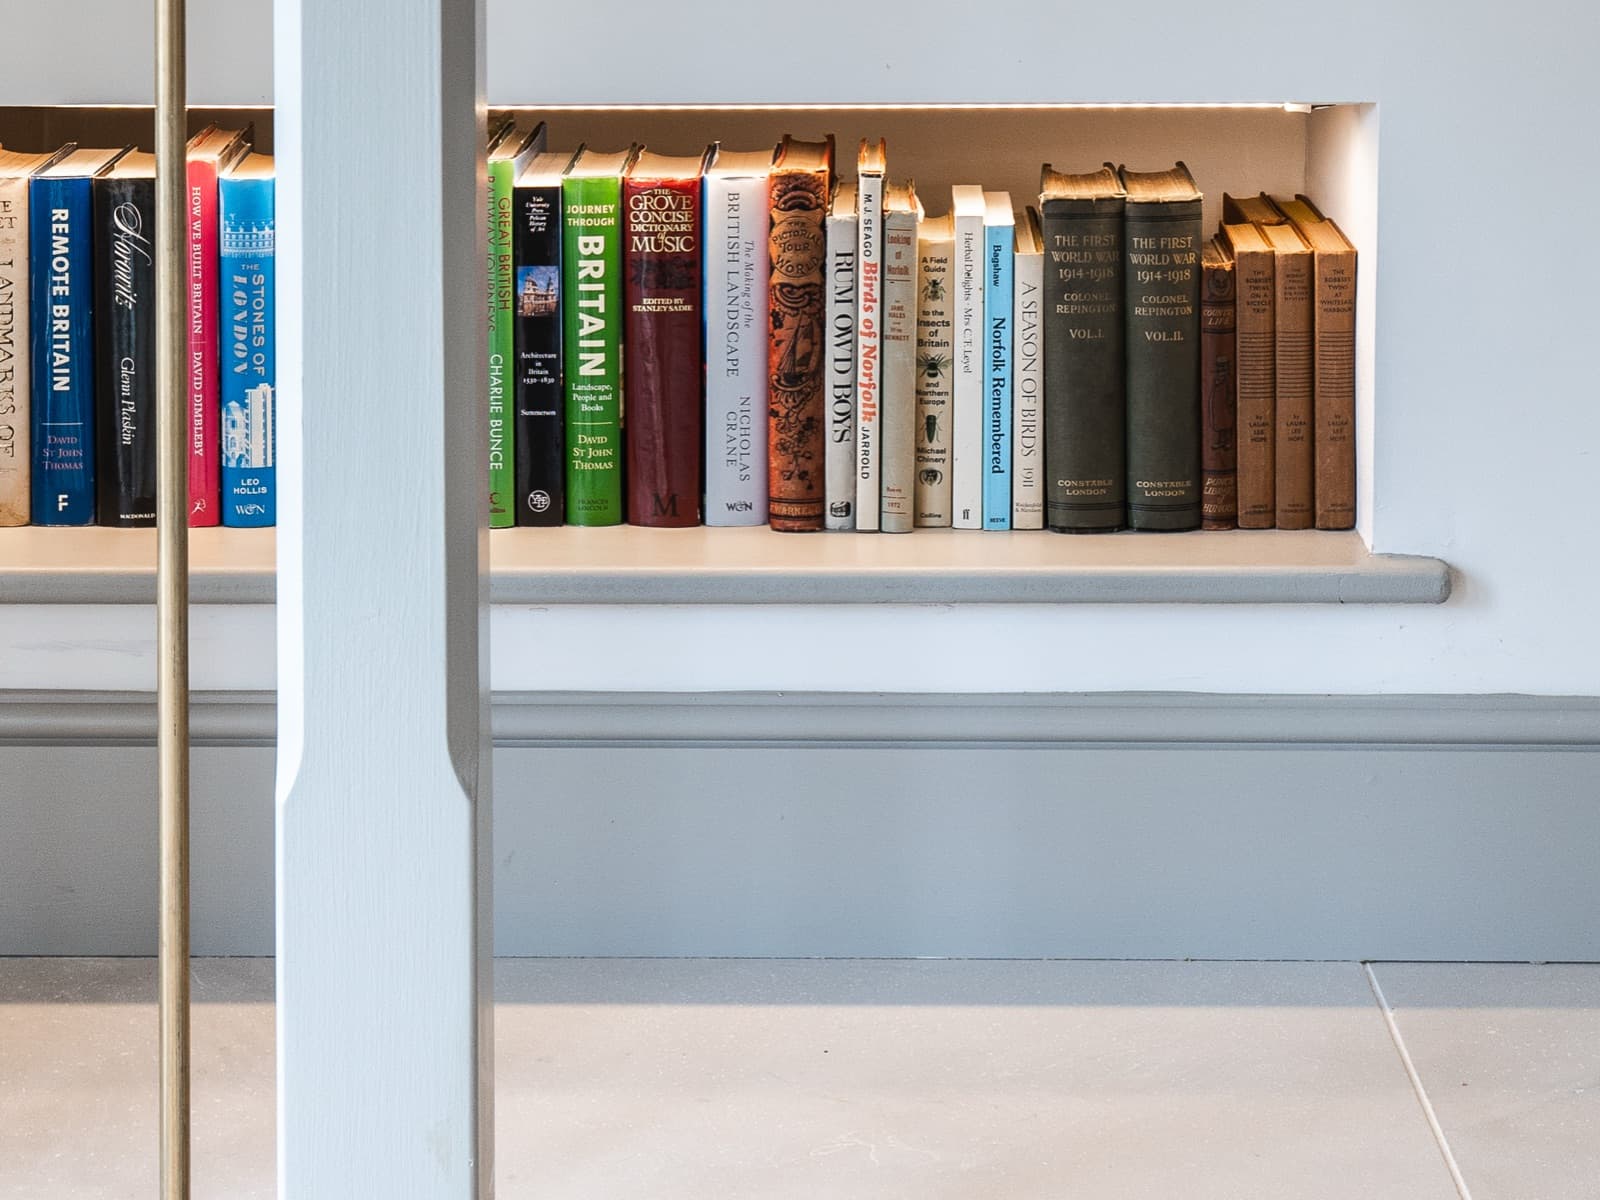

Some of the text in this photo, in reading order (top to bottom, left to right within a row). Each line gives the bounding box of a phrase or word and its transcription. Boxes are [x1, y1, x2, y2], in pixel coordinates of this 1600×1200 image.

[566, 204, 615, 214] JOURNEY
[629, 195, 694, 211] GROVE
[567, 217, 615, 227] THROUGH
[630, 211, 694, 223] CONCISE
[630, 223, 694, 233] DICTIONARY
[772, 229, 821, 246] PICTORIAL
[864, 218, 873, 258] SEAGO
[1055, 236, 1115, 247] THE FIRST
[1132, 236, 1193, 249] THE FIRST
[631, 237, 695, 253] MUSIC
[743, 240, 755, 258] The
[779, 240, 810, 253] TOUR
[963, 232, 974, 262] Herbal
[191, 186, 202, 334] HOW WE BUILT BRITAIN
[497, 197, 511, 311] GREAT BRITISH
[930, 256, 948, 264] Field
[1051, 251, 1120, 263] WORLD WAR
[1130, 252, 1196, 265] WORLD WAR
[775, 255, 819, 275] WORLD
[924, 265, 946, 273] Guide
[991, 244, 1002, 287] Bagshaw
[741, 262, 754, 298] Making
[1059, 268, 1114, 282] 1914-1918
[1137, 270, 1191, 283] 1914-1918
[726, 192, 740, 378] BRITISH LANDSCAPE
[863, 261, 878, 313] Birds
[961, 264, 974, 301] Delights
[1021, 281, 1038, 295] A
[52, 208, 70, 392] REMOTE BRITAIN
[1063, 292, 1110, 303] COLONEL
[1142, 294, 1189, 304] COLONEL
[577, 235, 606, 376] BRITAIN
[1056, 304, 1116, 315] REPINGTON
[1134, 306, 1193, 317] REPINGTON
[233, 275, 248, 374] LONDON
[252, 274, 265, 376] STONES OF
[743, 314, 754, 329] the
[860, 318, 877, 338] of
[918, 319, 951, 327] Insects
[929, 329, 938, 337] of
[1021, 301, 1038, 372] SEASON
[831, 249, 855, 444] RUM OWD BOYS
[917, 339, 950, 348] Britain
[572, 383, 613, 392] Landscape,
[859, 343, 877, 423] Norfolk
[572, 393, 613, 402] People and
[917, 389, 949, 397] Northern
[991, 317, 1006, 475] Norfolk Remembered
[1021, 381, 1037, 404] OF
[120, 357, 137, 445] Glenn Plaskin
[193, 352, 203, 456] DAVID DIMBLEBY
[919, 398, 946, 406] Europe
[490, 354, 503, 470] CHARLIE BUNCE
[47, 435, 78, 444] DAVID
[578, 435, 608, 444] DAVID
[726, 411, 737, 467] CRANE
[739, 396, 751, 482] NICHOLAS
[1021, 409, 1037, 457] BIRDS
[58, 447, 83, 458] JOHN
[588, 448, 613, 458] JOHN
[860, 427, 870, 480] JARROLD
[917, 447, 947, 455] Michael
[42, 461, 83, 471] THOMAS
[572, 460, 614, 470] THOMAS
[918, 456, 946, 465] Chinery
[1058, 480, 1113, 488] CONSTABLE
[1136, 480, 1192, 489] CONSTABLE
[233, 487, 268, 495] HOLLIS
[1066, 488, 1106, 496] LONDON
[1145, 489, 1186, 498] LONDON
